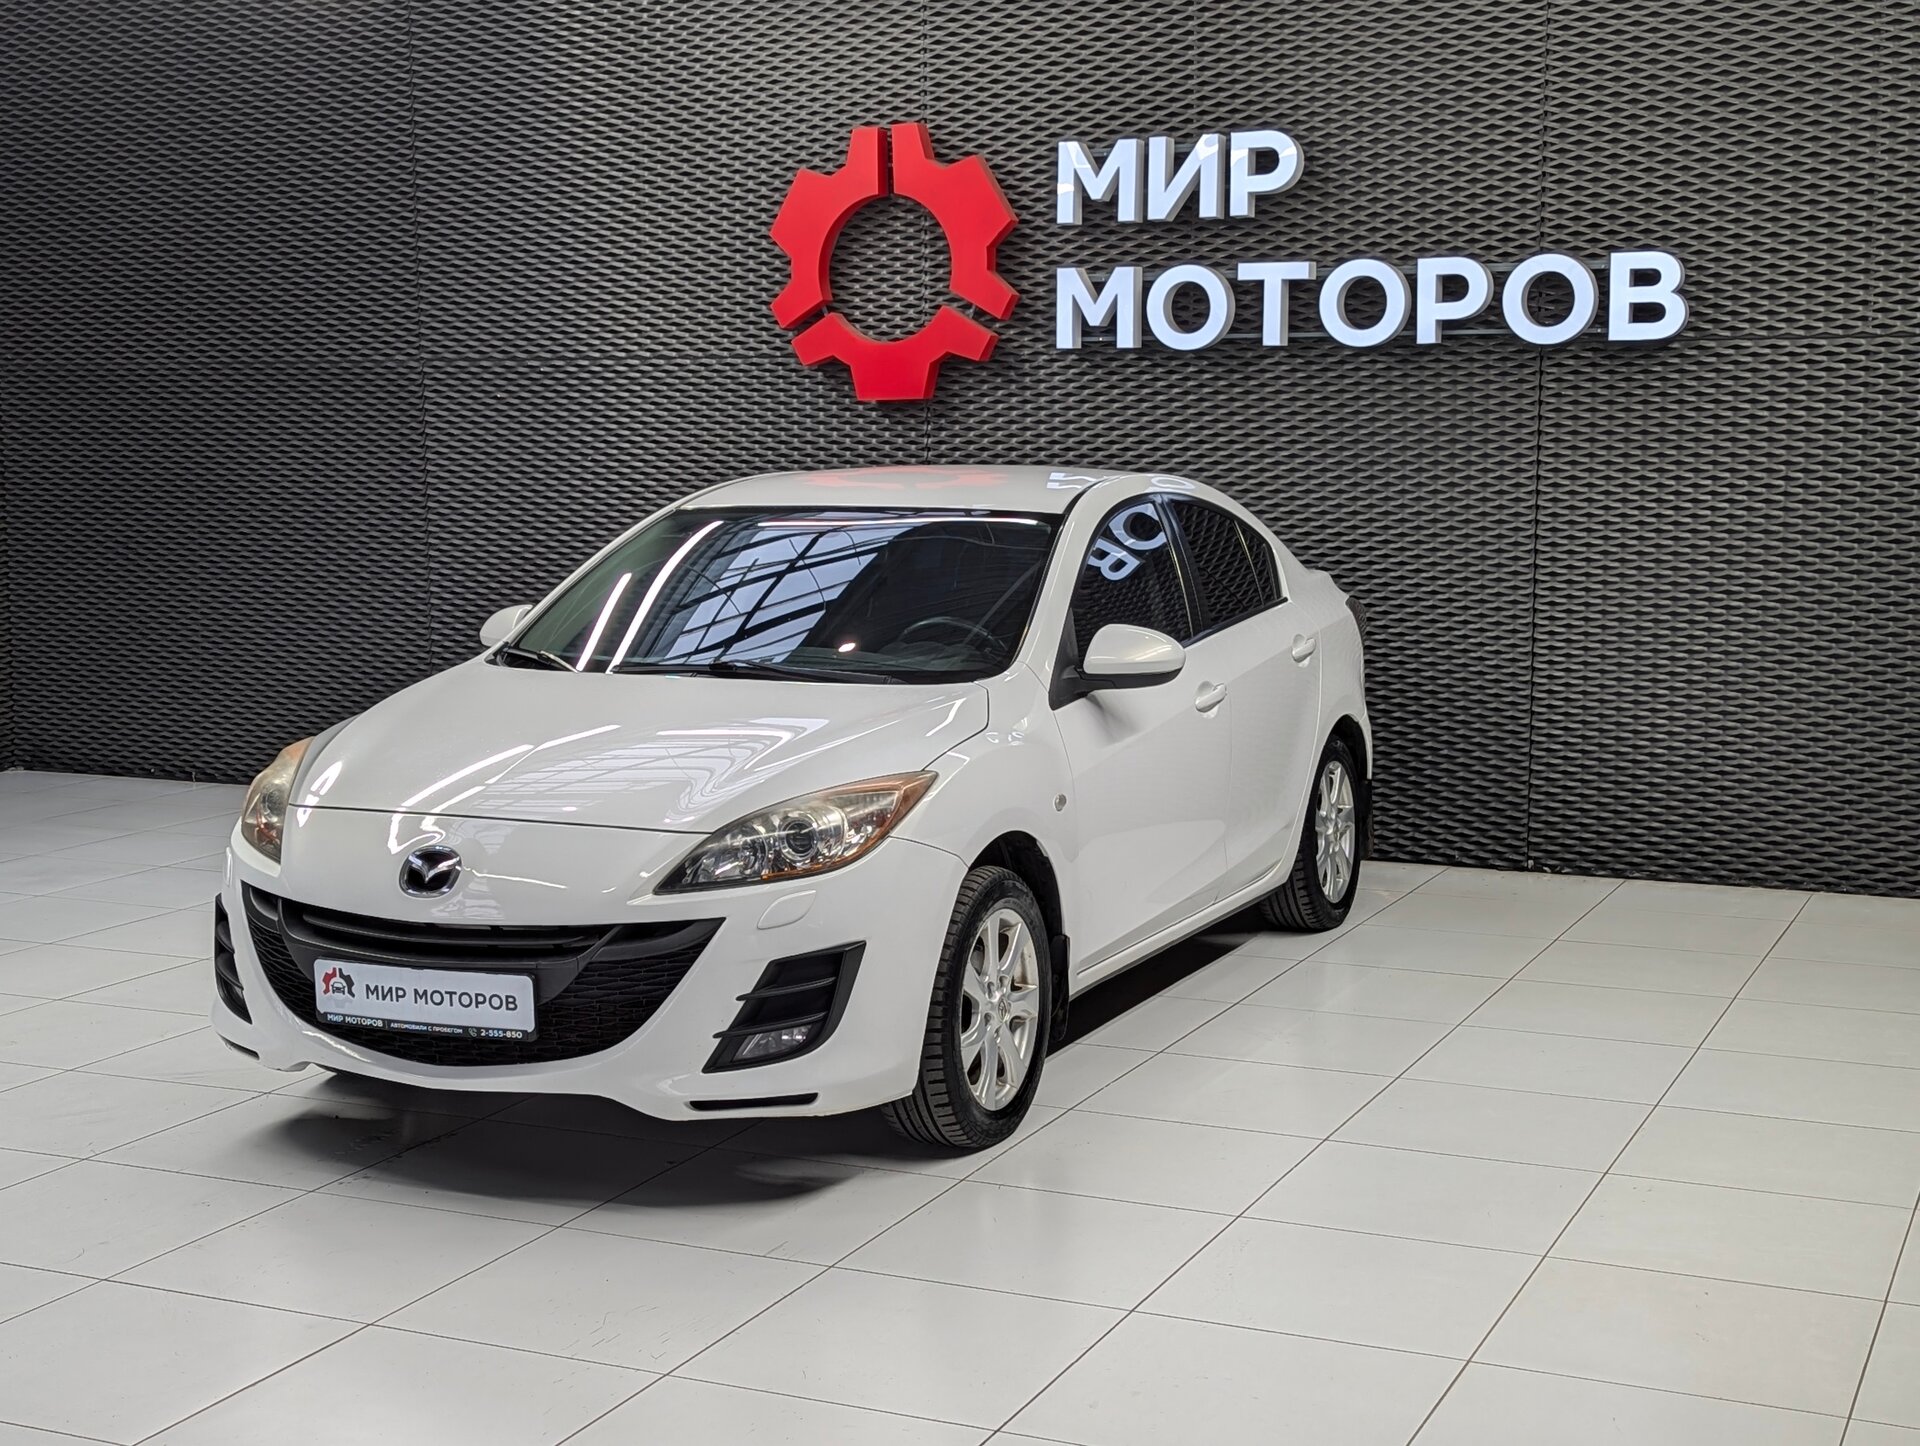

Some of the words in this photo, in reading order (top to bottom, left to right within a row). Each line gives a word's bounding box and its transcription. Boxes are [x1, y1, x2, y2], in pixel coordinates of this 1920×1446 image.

[1056, 129, 1304, 225] МИР
[1055, 250, 1689, 351] МОТОРОВ
[327, 1013, 343, 1023] МИР
[345, 1015, 383, 1027] МОТОРОВ
[390, 1022, 427, 1031] АВТОМОБИЛИ
[432, 1026, 463, 1034] ПРОБЕГОМ
[480, 1029, 523, 1039] 2-555-850
[365, 984, 407, 1002] МИР
[413, 988, 518, 1011] МОТОРОВ
